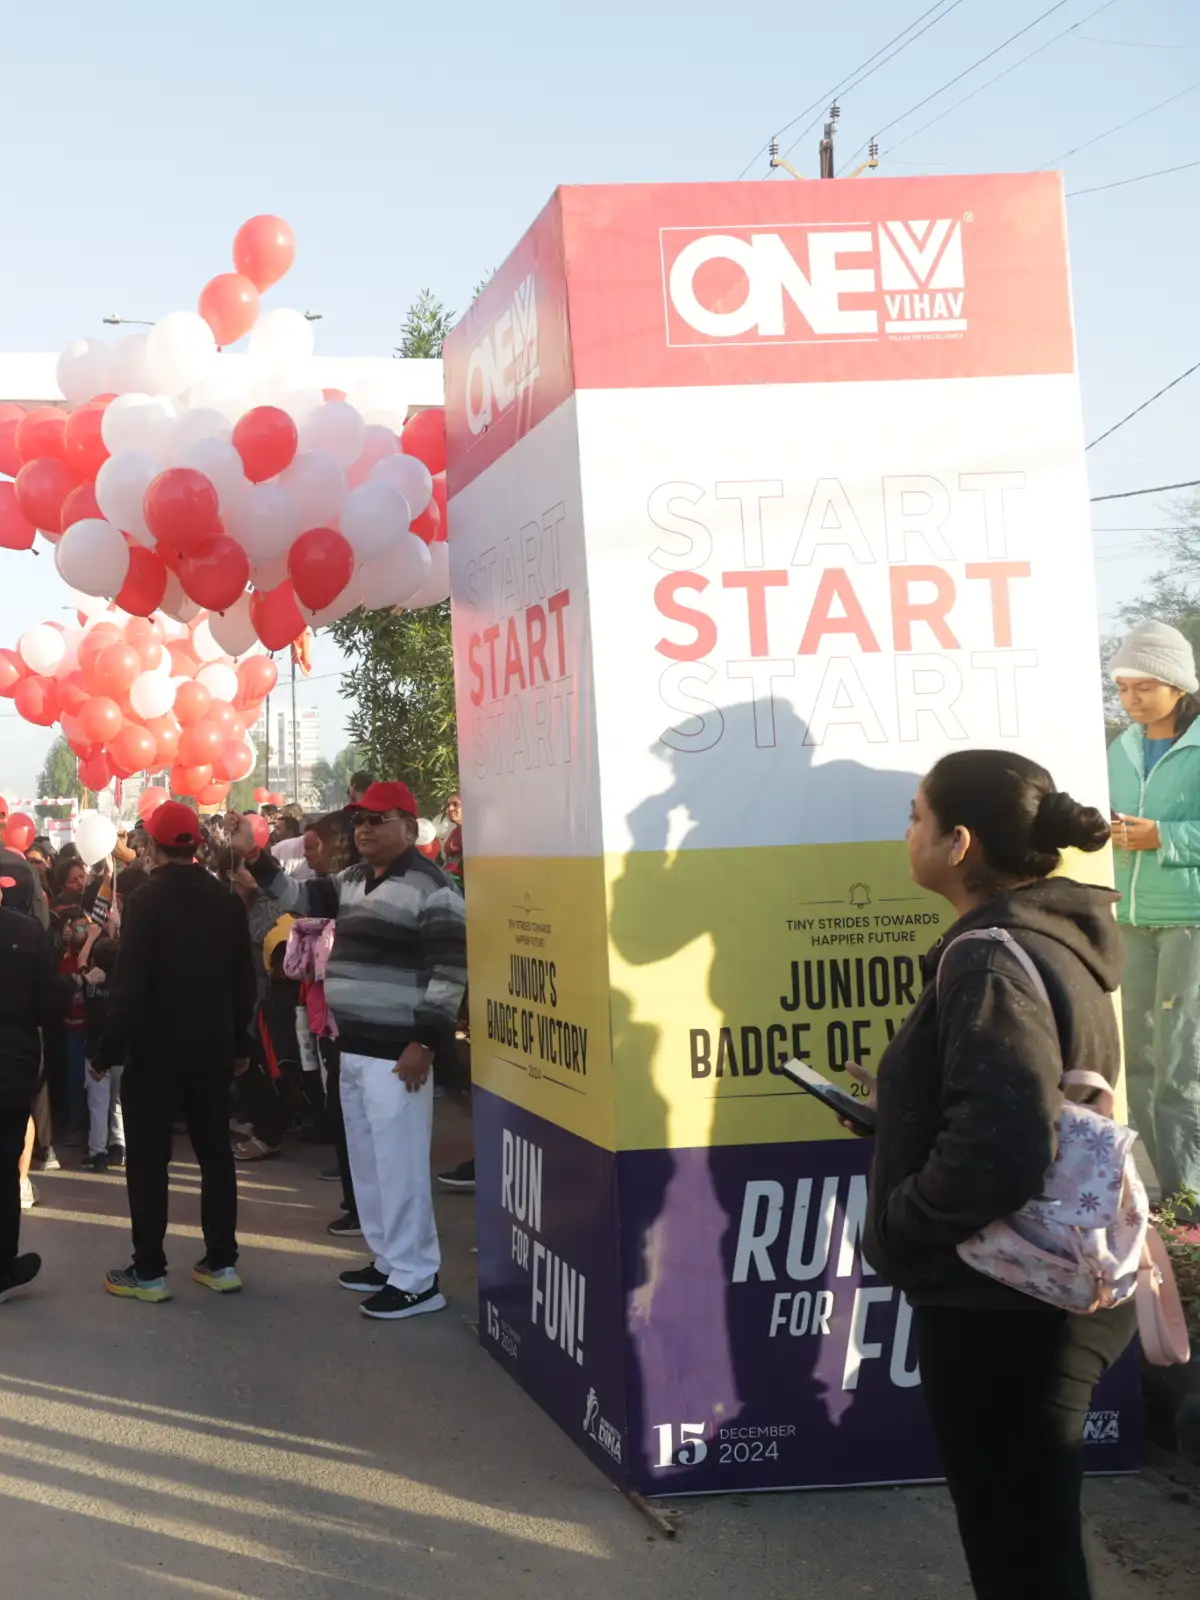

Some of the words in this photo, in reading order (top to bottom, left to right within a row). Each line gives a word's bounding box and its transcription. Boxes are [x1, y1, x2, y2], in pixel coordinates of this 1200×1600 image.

[670, 232, 878, 337] ONE
[883, 292, 964, 320] VIHAV
[465, 305, 516, 436] ONE
[648, 471, 1026, 571] START
[464, 500, 566, 624] START
[468, 588, 571, 706] START
[653, 561, 1031, 661] START
[658, 649, 1038, 753] START
[786, 919, 814, 931] TINY
[818, 917, 869, 930] STRIDES
[873, 913, 940, 927] TOWARDS
[811, 934, 864, 947] HAPPIER
[868, 931, 916, 944] FUTURE
[508, 954, 557, 1008] JUNIOR'S
[487, 998, 519, 1050] BADGE
[521, 1008, 534, 1055] OF
[537, 1013, 588, 1076] VICTORY
[689, 1023, 812, 1079] BADGE
[827, 1020, 871, 1073] OF
[850, 1083, 870, 1097] 20
[501, 1128, 543, 1233] RUN
[511, 1225, 529, 1272] FOR
[531, 1240, 586, 1367] FUN!
[769, 1290, 834, 1338] FOR
[653, 1422, 708, 1468] 15
[720, 1425, 796, 1440] DECEMBER
[719, 1441, 780, 1463] 2024
